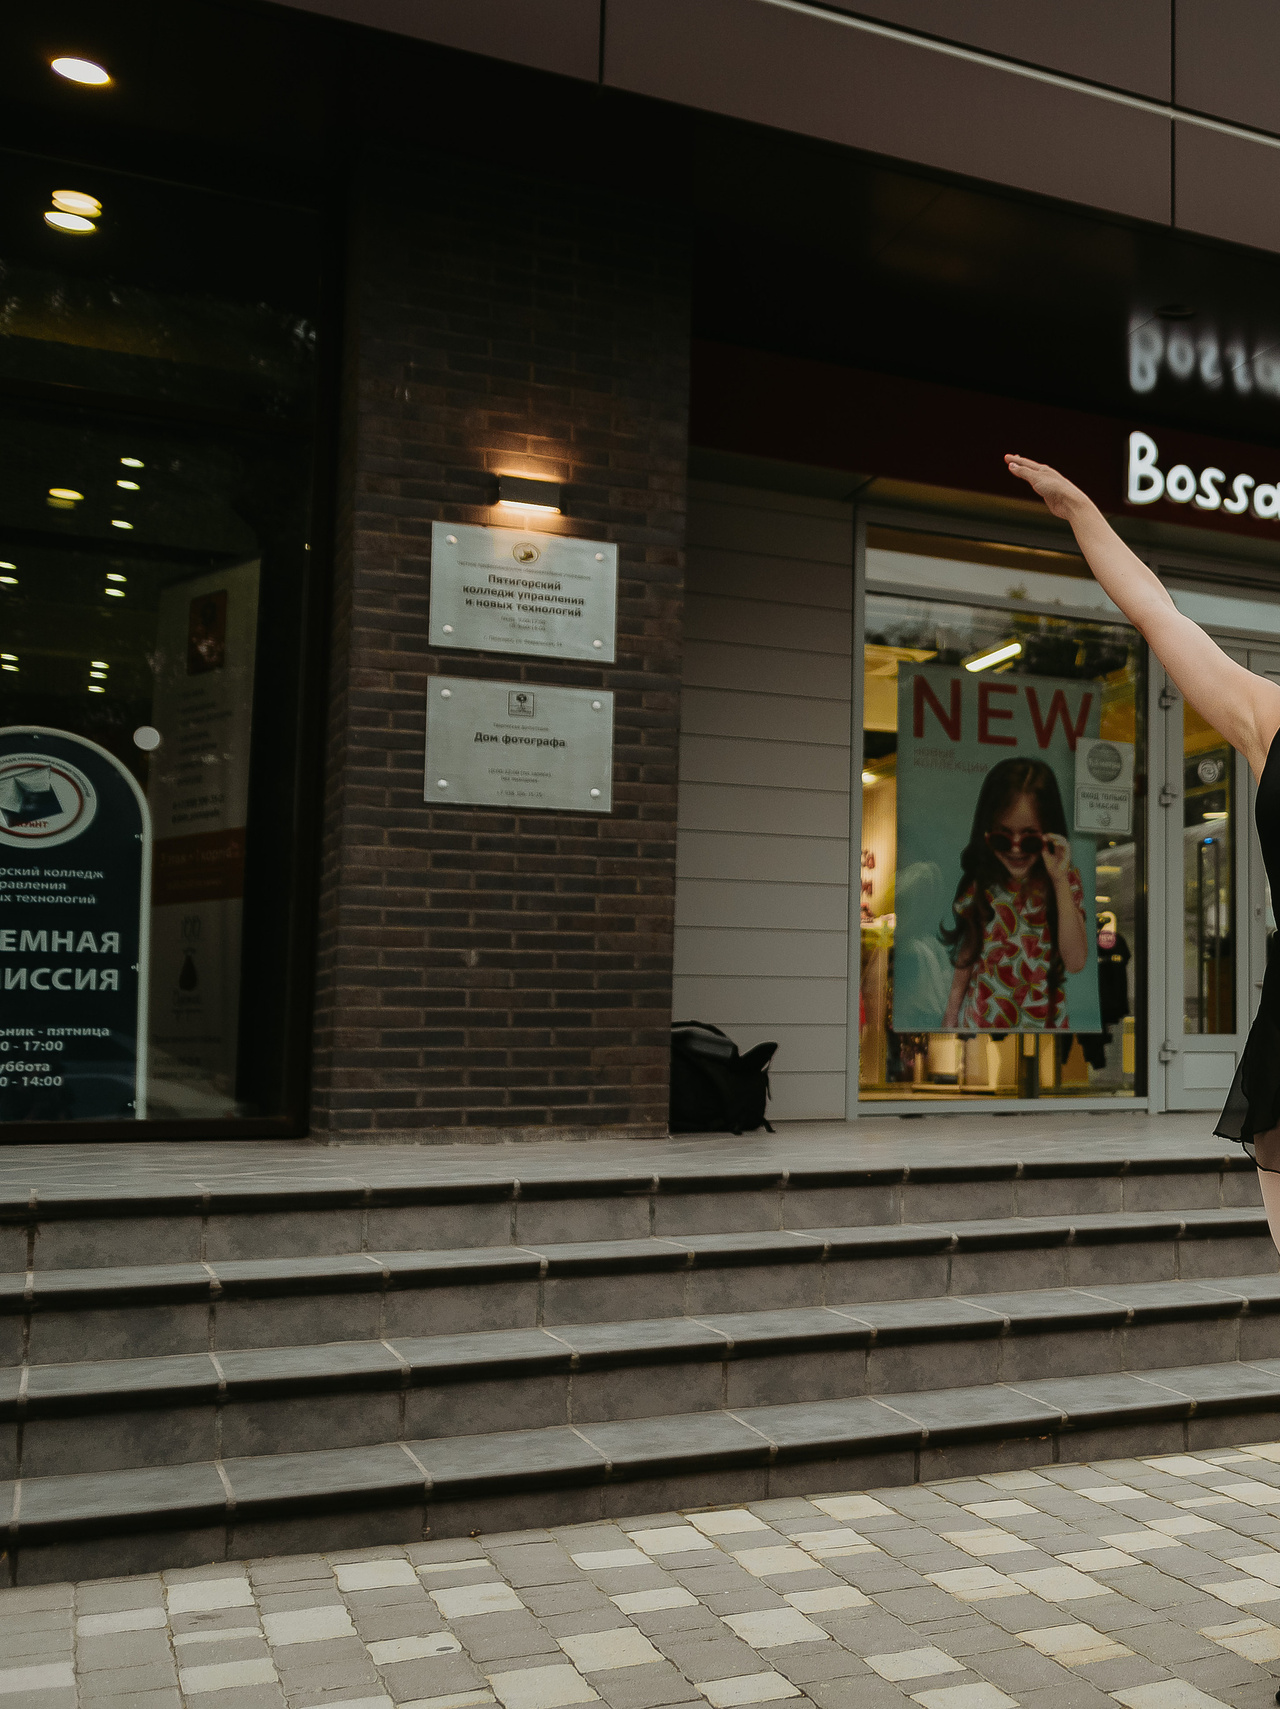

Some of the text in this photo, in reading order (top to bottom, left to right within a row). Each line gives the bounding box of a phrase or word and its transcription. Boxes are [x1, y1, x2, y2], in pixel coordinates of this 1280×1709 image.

[488, 573, 562, 591] Пятигорский
[462, 585, 585, 606] колледж управления
[465, 598, 582, 617] и новых технологий
[912, 673, 1094, 753] NEW
[474, 731, 566, 748] Дом фотографа
[44, 869, 104, 880] колледж
[16, 893, 96, 905] технологий
[0, 929, 120, 954] ЕМНАЯ
[46, 1027, 110, 1038] пятница
[23, 1041, 64, 1051] 17:00
[21, 1076, 62, 1087] 14:00
